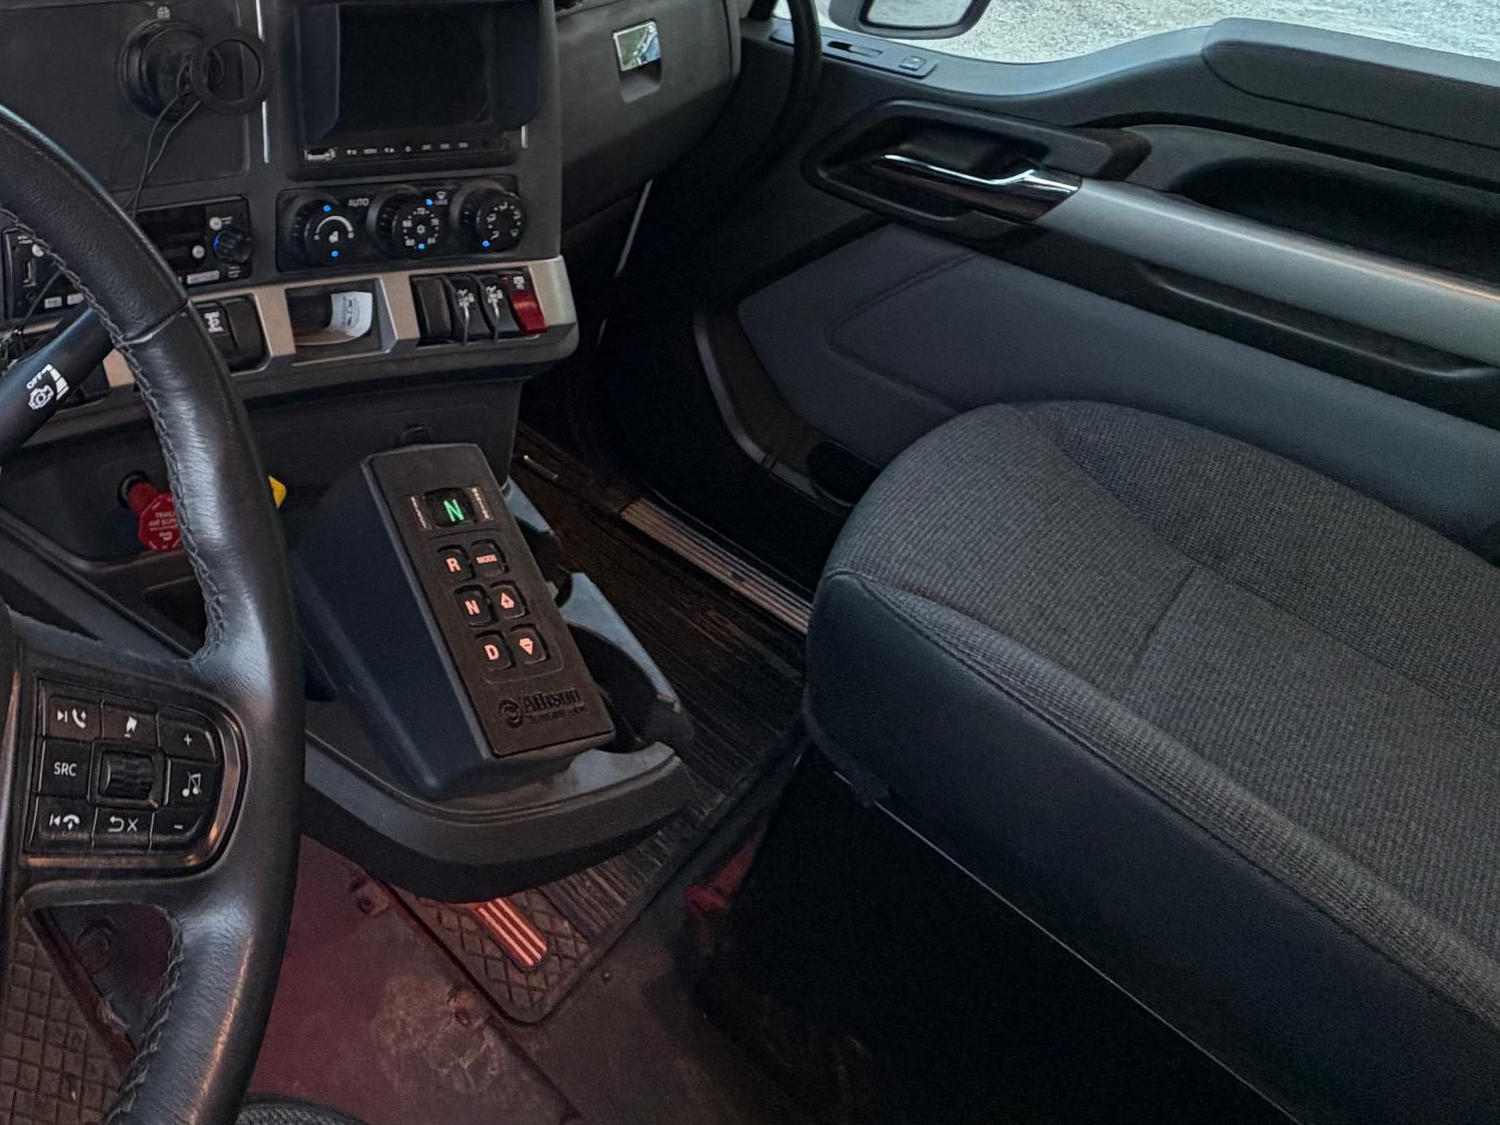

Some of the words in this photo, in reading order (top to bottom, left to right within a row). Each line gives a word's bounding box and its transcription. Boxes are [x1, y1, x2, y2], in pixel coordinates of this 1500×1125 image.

[348, 197, 370, 208] AUTO
[443, 498, 465, 523] N
[445, 557, 462, 573] R
[464, 599, 481, 616] N
[484, 644, 500, 661] D
[53, 761, 78, 777] SRC
